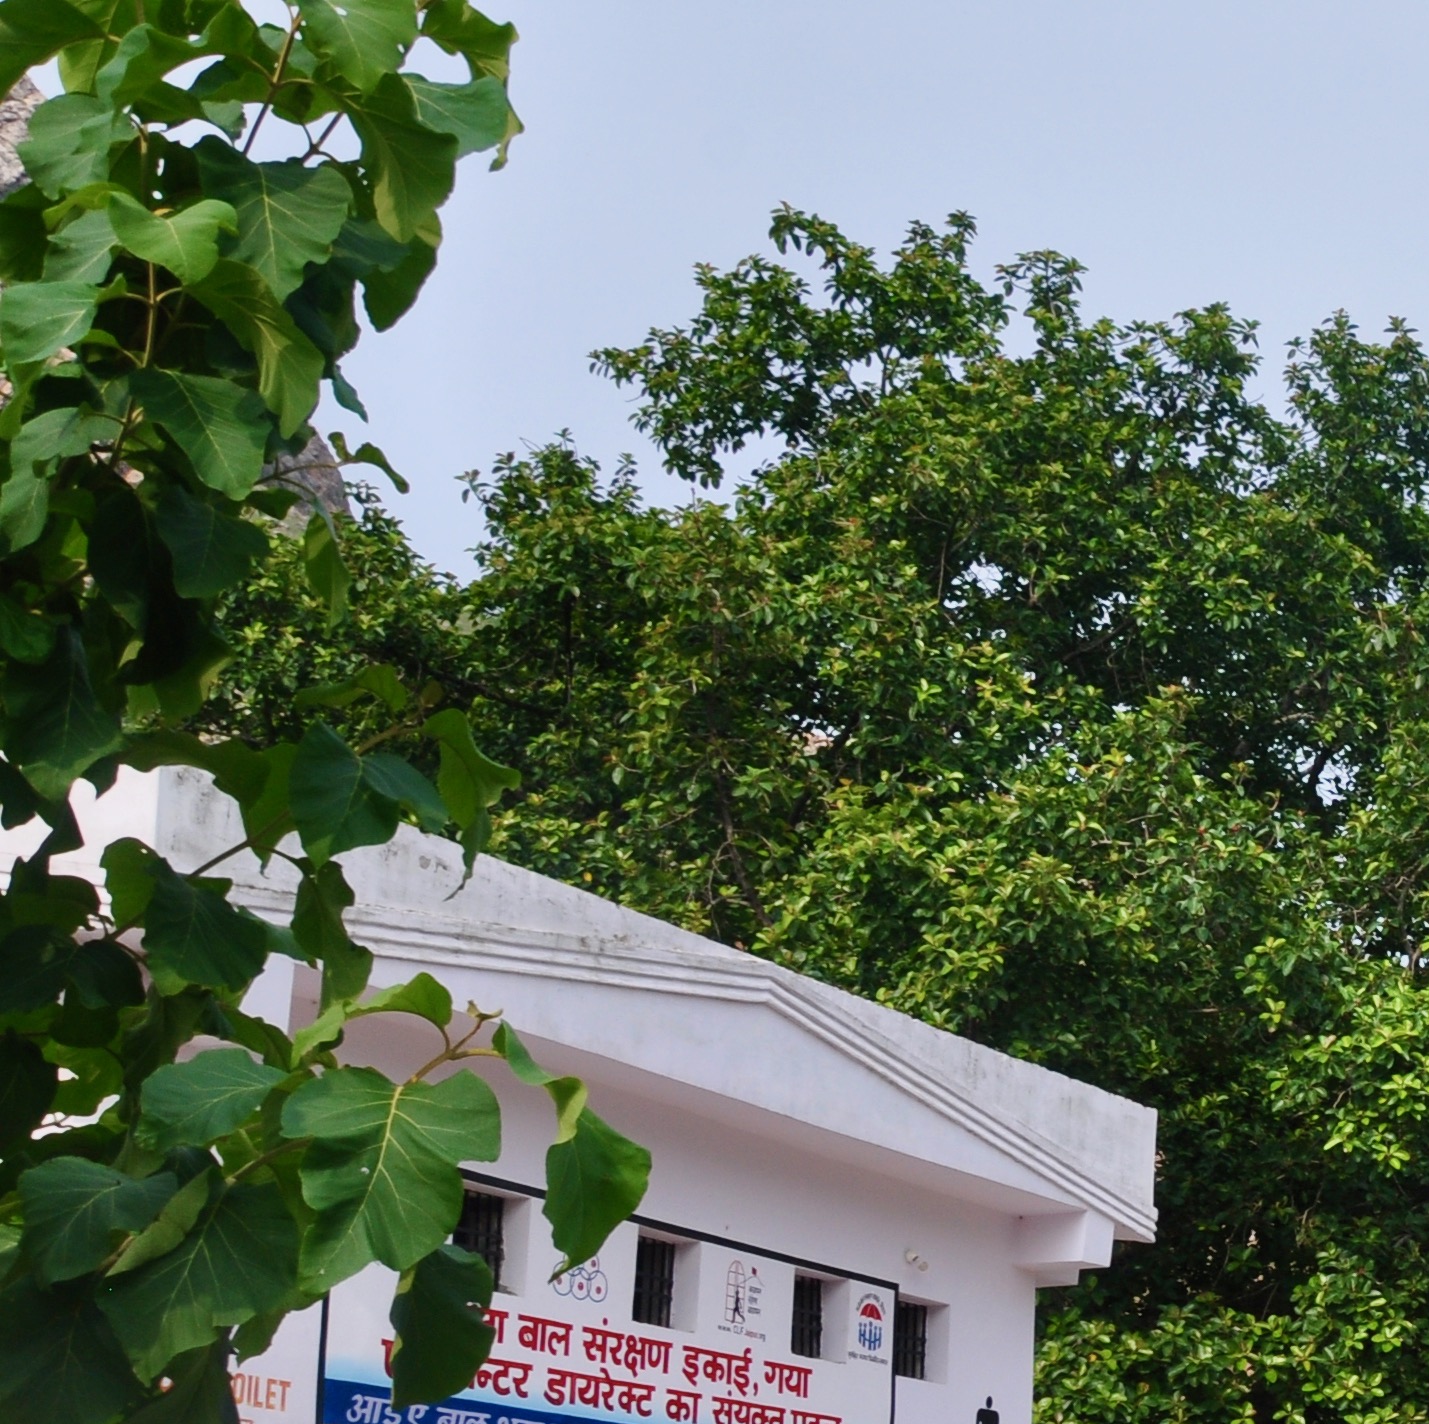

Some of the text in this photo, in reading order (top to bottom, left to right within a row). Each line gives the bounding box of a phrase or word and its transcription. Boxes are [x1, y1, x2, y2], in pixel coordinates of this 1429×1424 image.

[518, 1314, 573, 1356] बाल
[583, 1317, 673, 1377] संरक्षण
[764, 1361, 813, 1398] गया
[231, 1373, 291, 1411] OILET
[544, 1367, 655, 1417] डायरेक्ट
[666, 1389, 702, 1424] का
